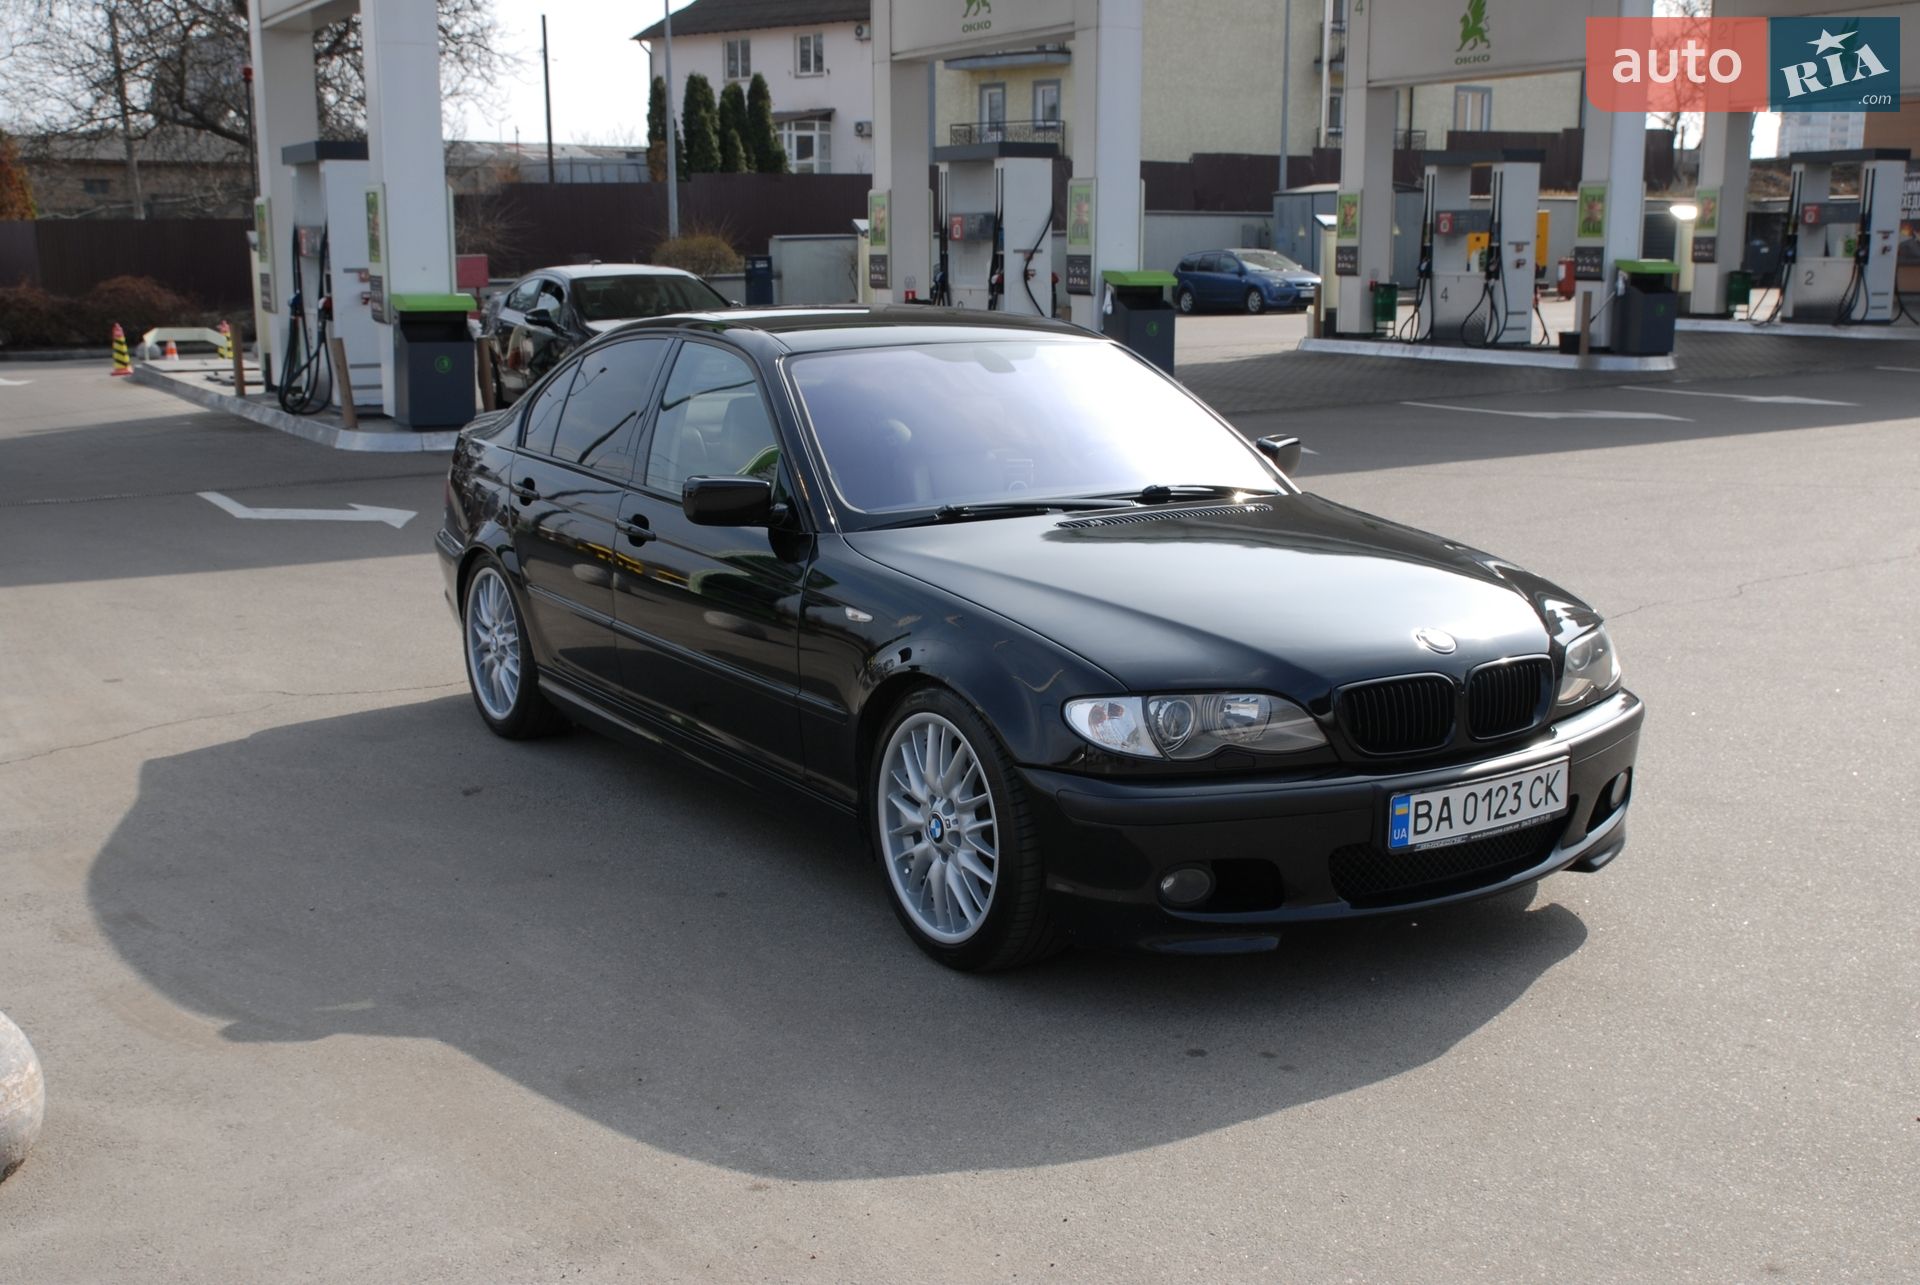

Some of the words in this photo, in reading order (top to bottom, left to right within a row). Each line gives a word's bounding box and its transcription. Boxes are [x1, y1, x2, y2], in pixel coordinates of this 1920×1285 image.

[1804, 271, 1815, 286] 2
[1440, 287, 1449, 302] 4
[1412, 796, 1454, 836] BA
[1463, 780, 1523, 826] 0123
[1529, 769, 1561, 809] CK
[1393, 828, 1408, 840] UA
